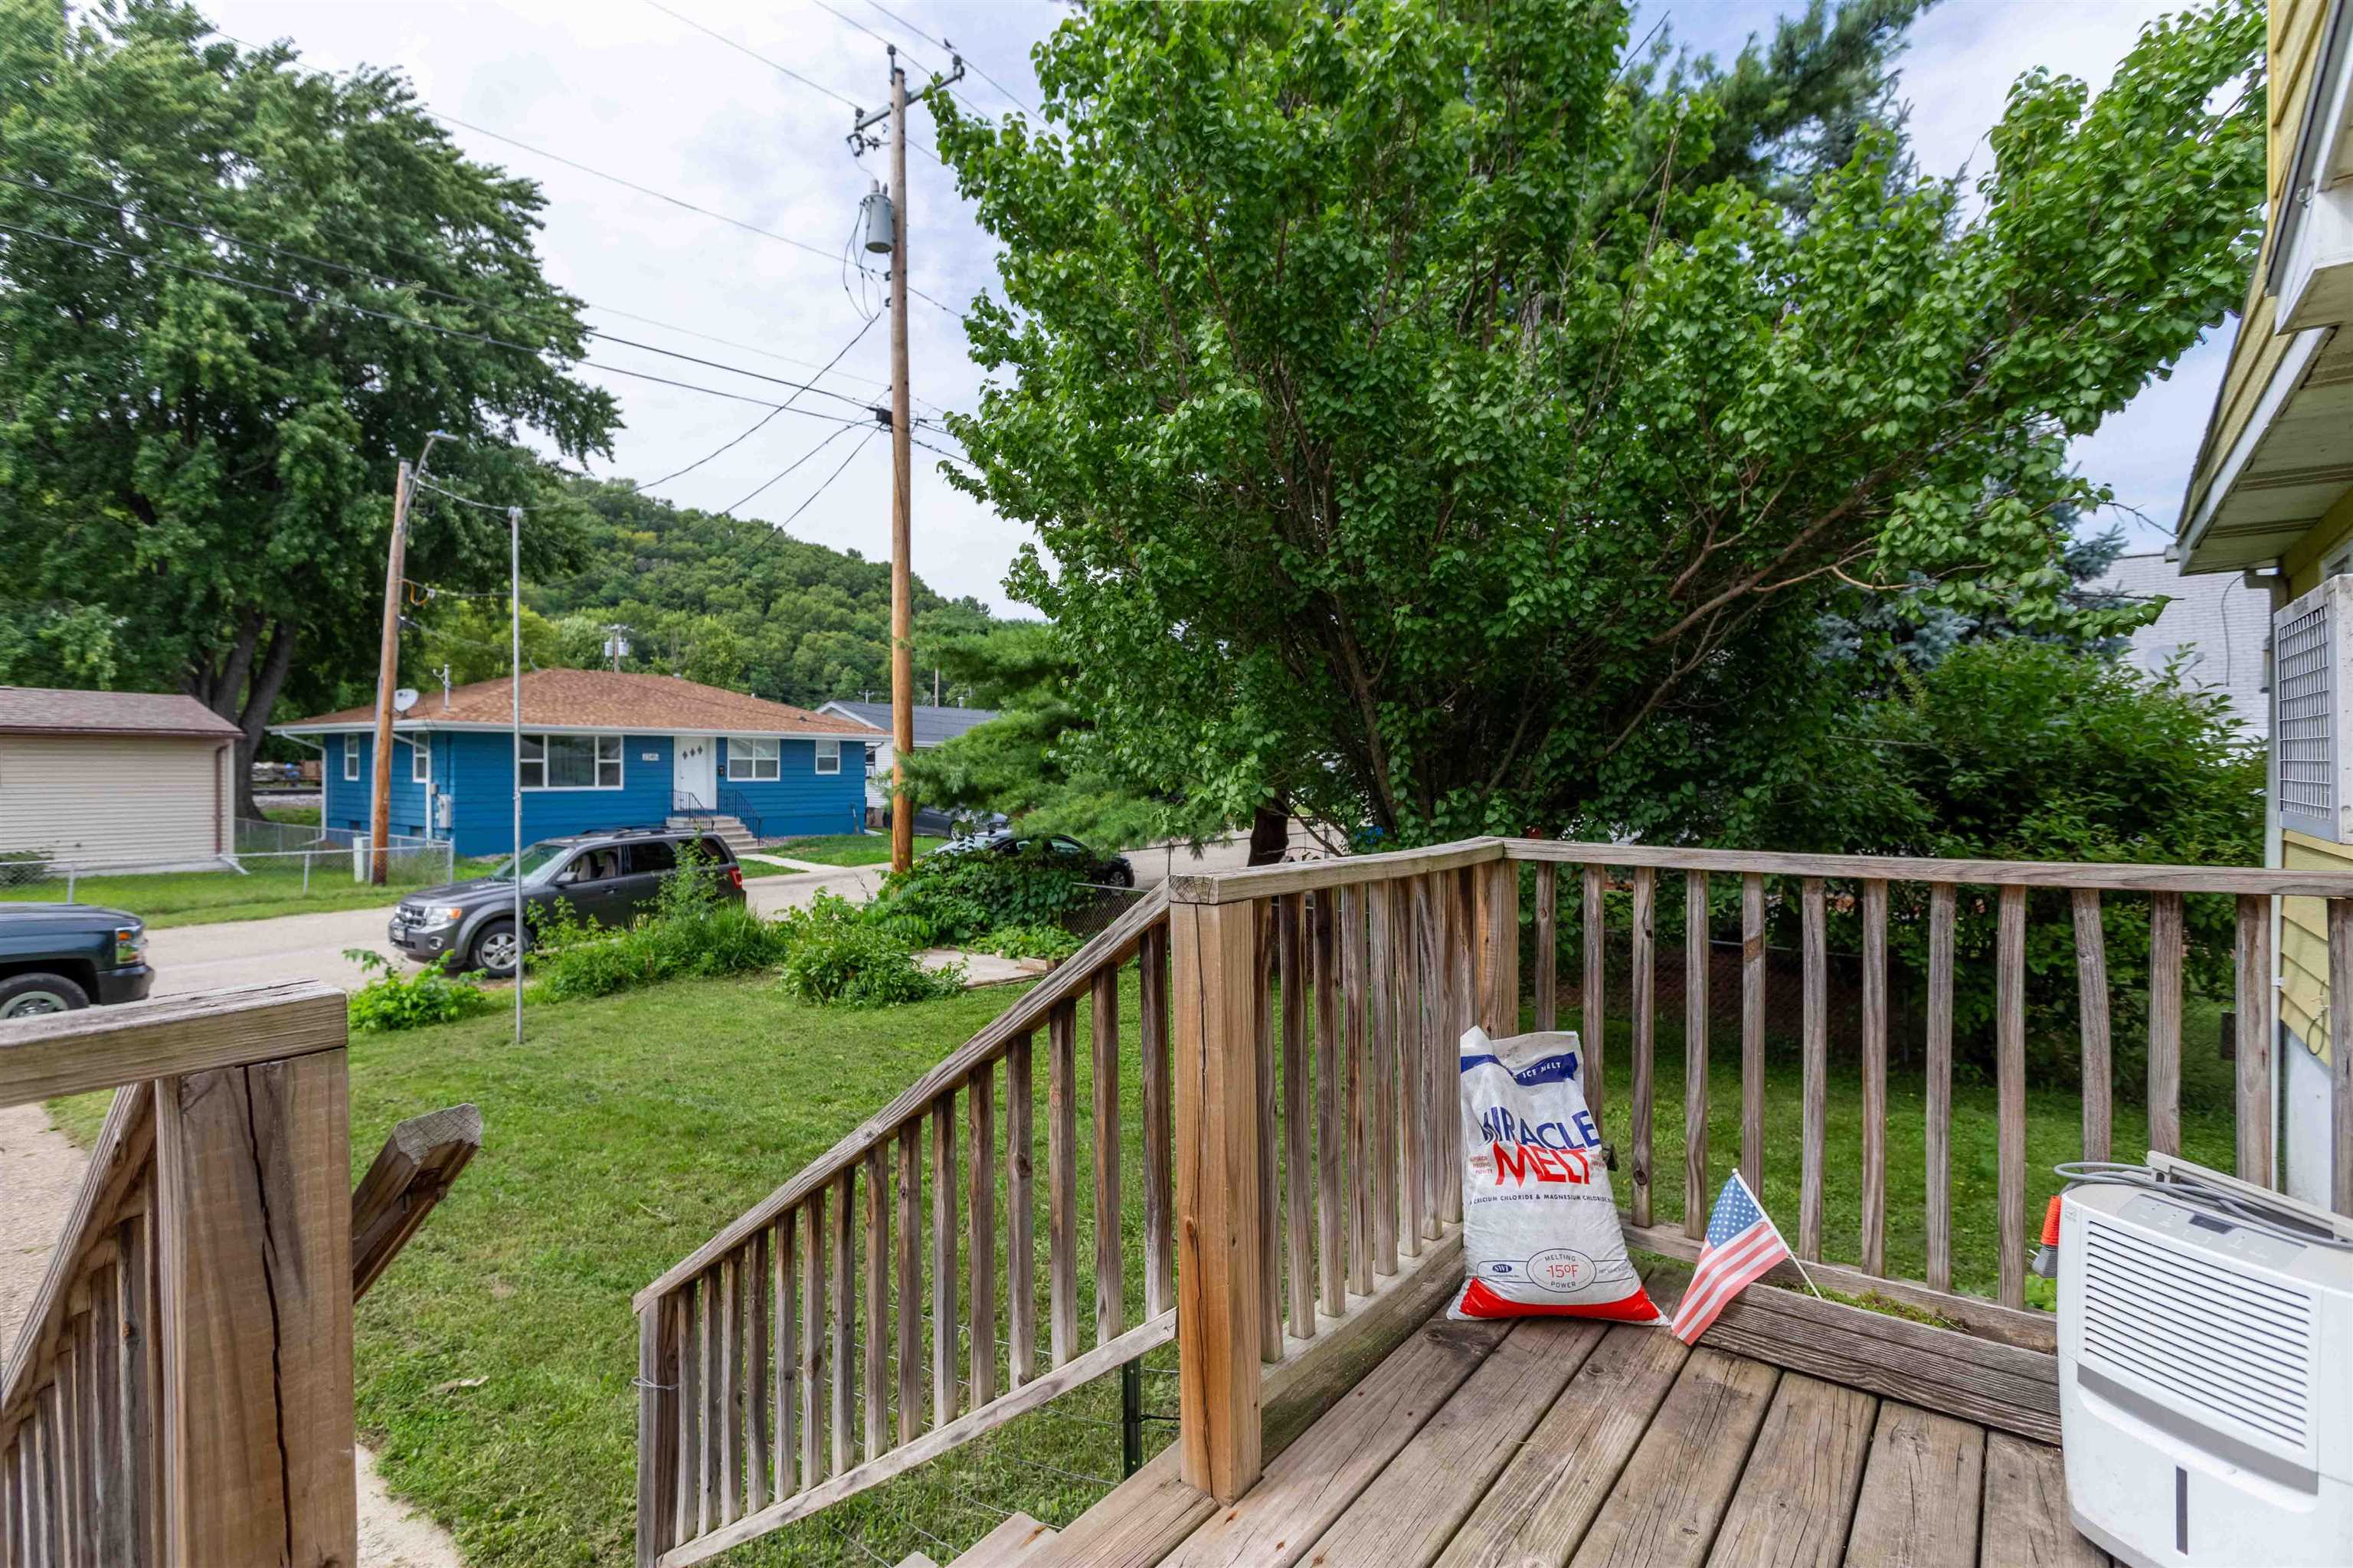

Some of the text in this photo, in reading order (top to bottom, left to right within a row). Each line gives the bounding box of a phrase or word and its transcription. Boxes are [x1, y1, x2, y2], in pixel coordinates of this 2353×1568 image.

[1523, 1062, 1561, 1079] ICE MELT
[1493, 1139, 1590, 1188] MELT
[1474, 1196, 1498, 1204] CALCIUM
[1544, 1254, 1576, 1262] MELTING
